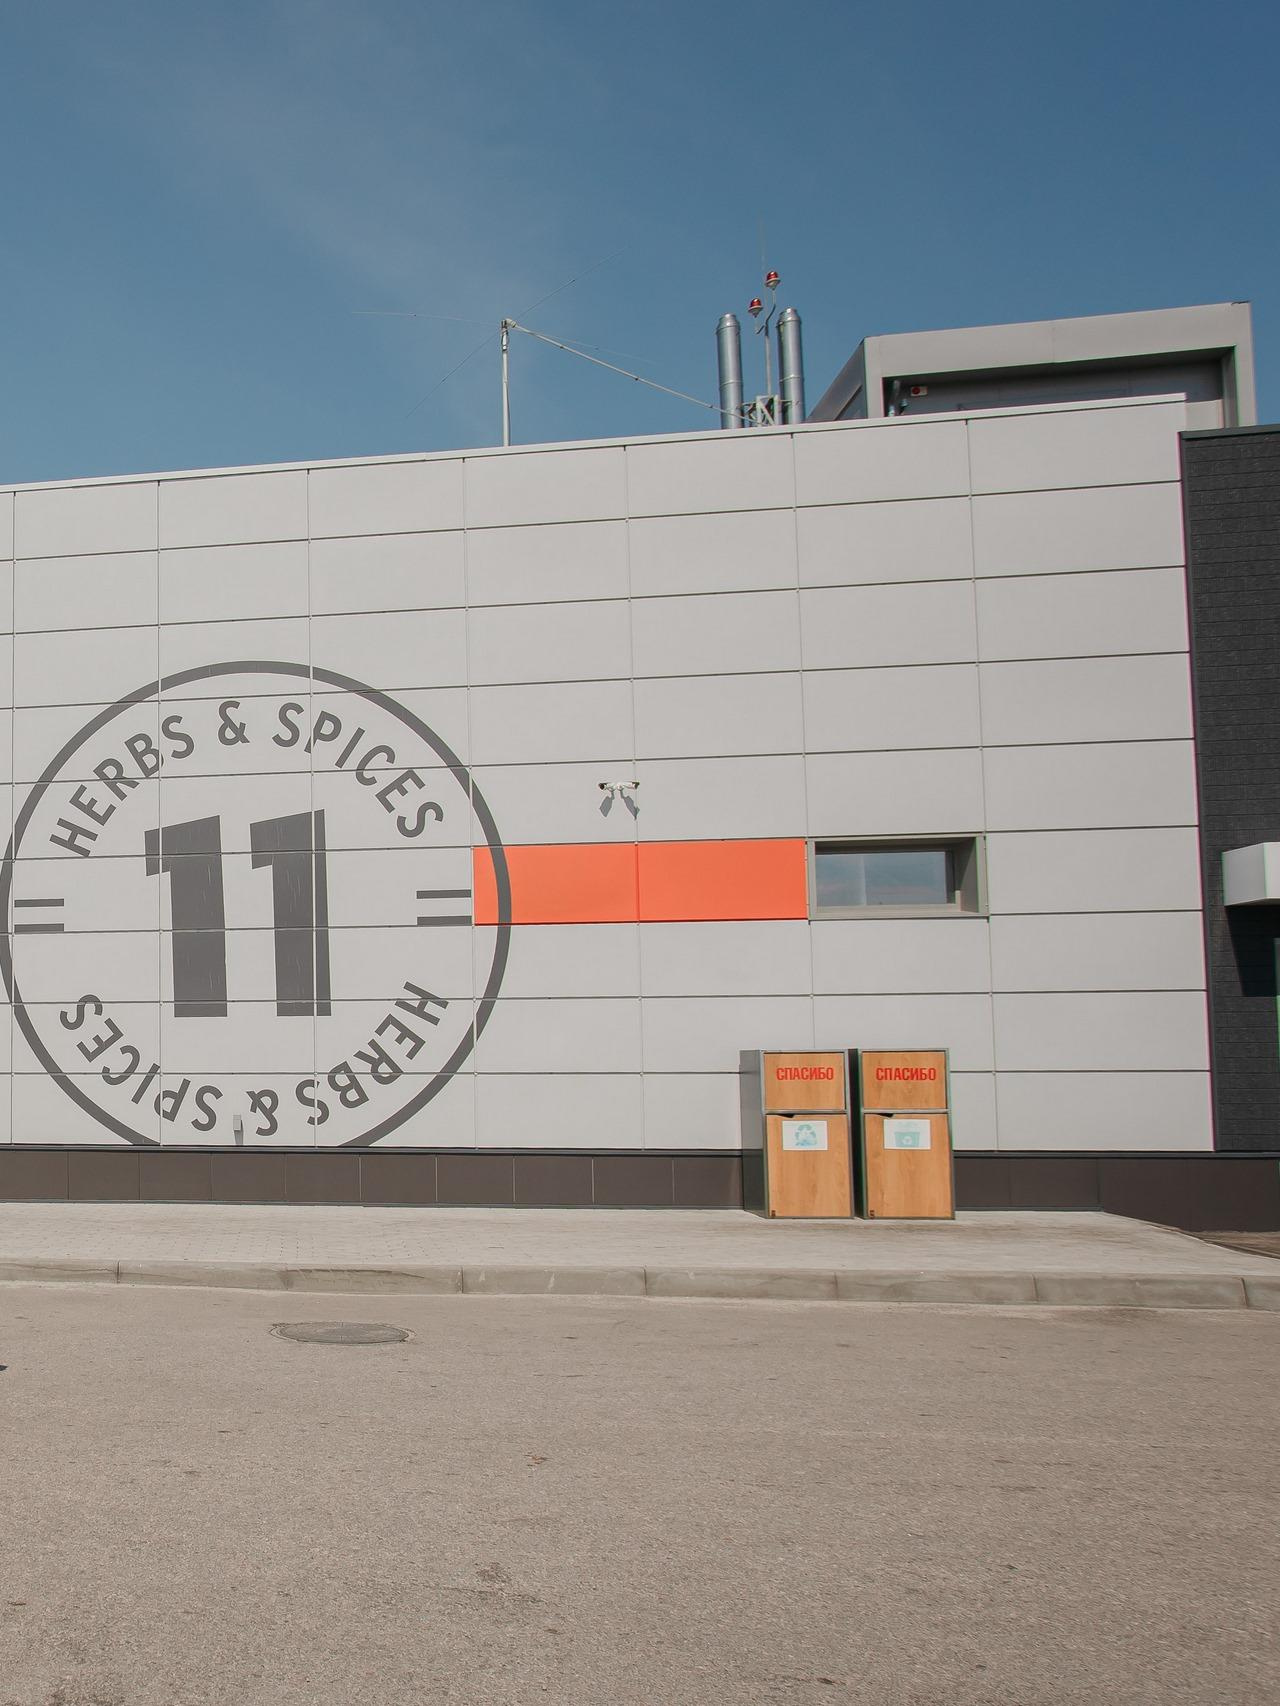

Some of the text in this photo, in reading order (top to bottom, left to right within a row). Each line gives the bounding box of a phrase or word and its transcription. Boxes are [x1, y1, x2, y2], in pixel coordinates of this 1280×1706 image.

[49, 700, 444, 857] HERBS & SPICES
[144, 808, 332, 1018] 11
[59, 981, 449, 1137] HERBS & SPICES
[775, 1066, 834, 1081] СПАСИБО
[875, 1067, 937, 1081] СПАСИБО
